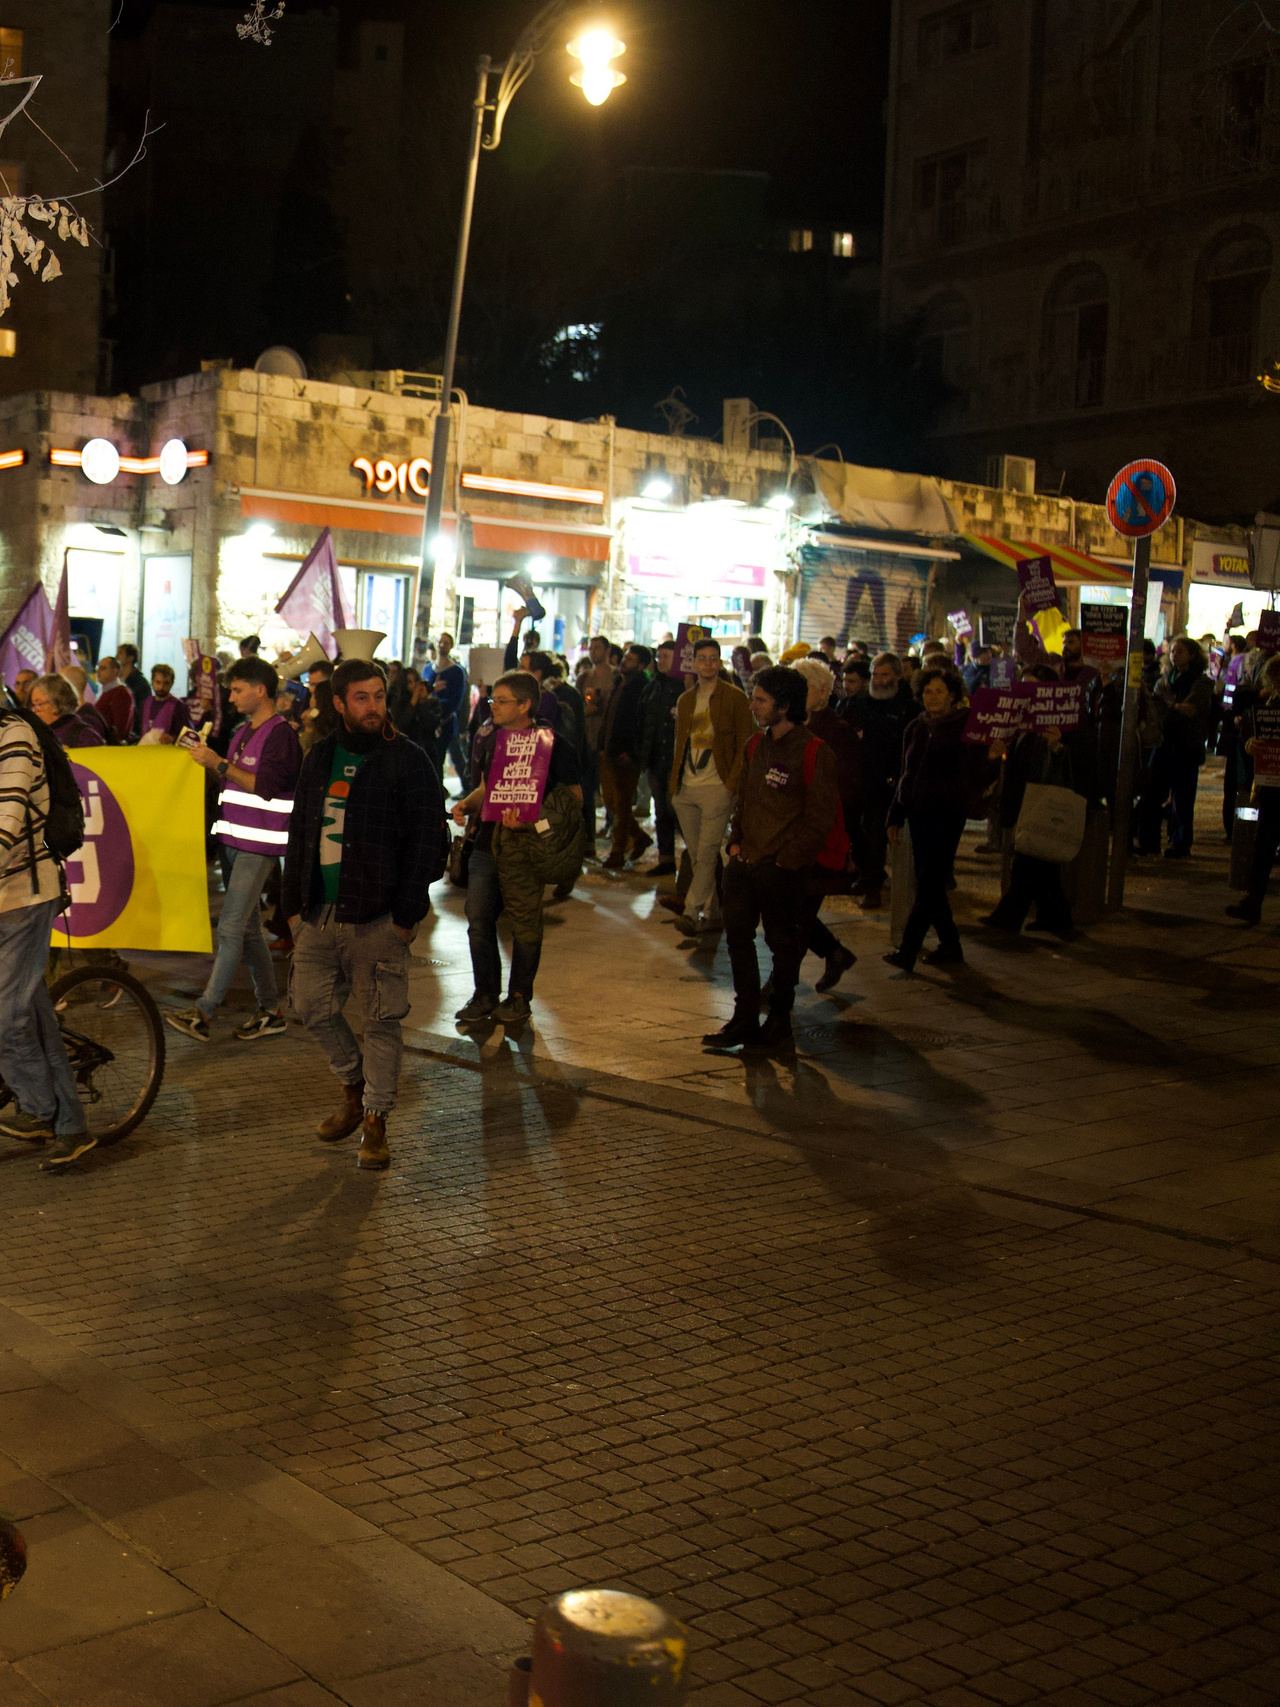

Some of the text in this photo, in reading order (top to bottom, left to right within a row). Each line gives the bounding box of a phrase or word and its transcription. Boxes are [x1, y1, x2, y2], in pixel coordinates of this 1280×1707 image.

[353, 456, 433, 497] סופר
[1036, 687, 1053, 698] את
[1036, 713, 1079, 725] המלחמה
[492, 792, 536, 802] דמוקרטיה
